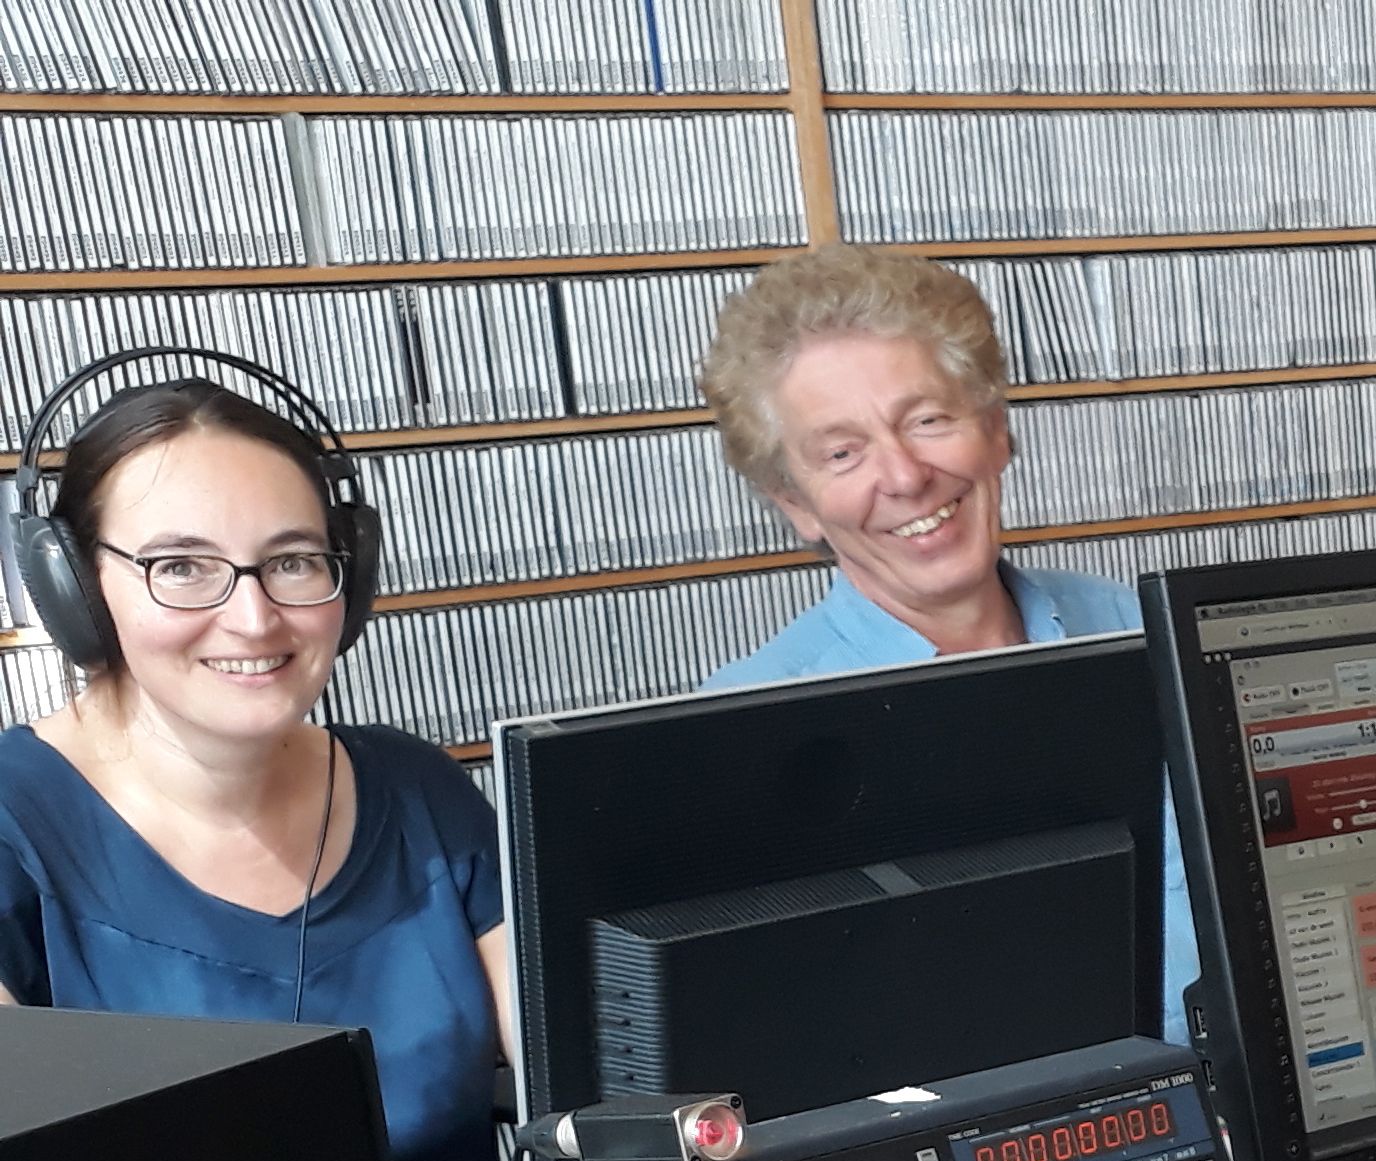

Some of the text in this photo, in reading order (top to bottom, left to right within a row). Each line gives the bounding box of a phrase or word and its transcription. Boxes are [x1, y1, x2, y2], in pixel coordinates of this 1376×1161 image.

[1252, 736, 1275, 755] 0,0
[1151, 1072, 1195, 1093] DM 1000
